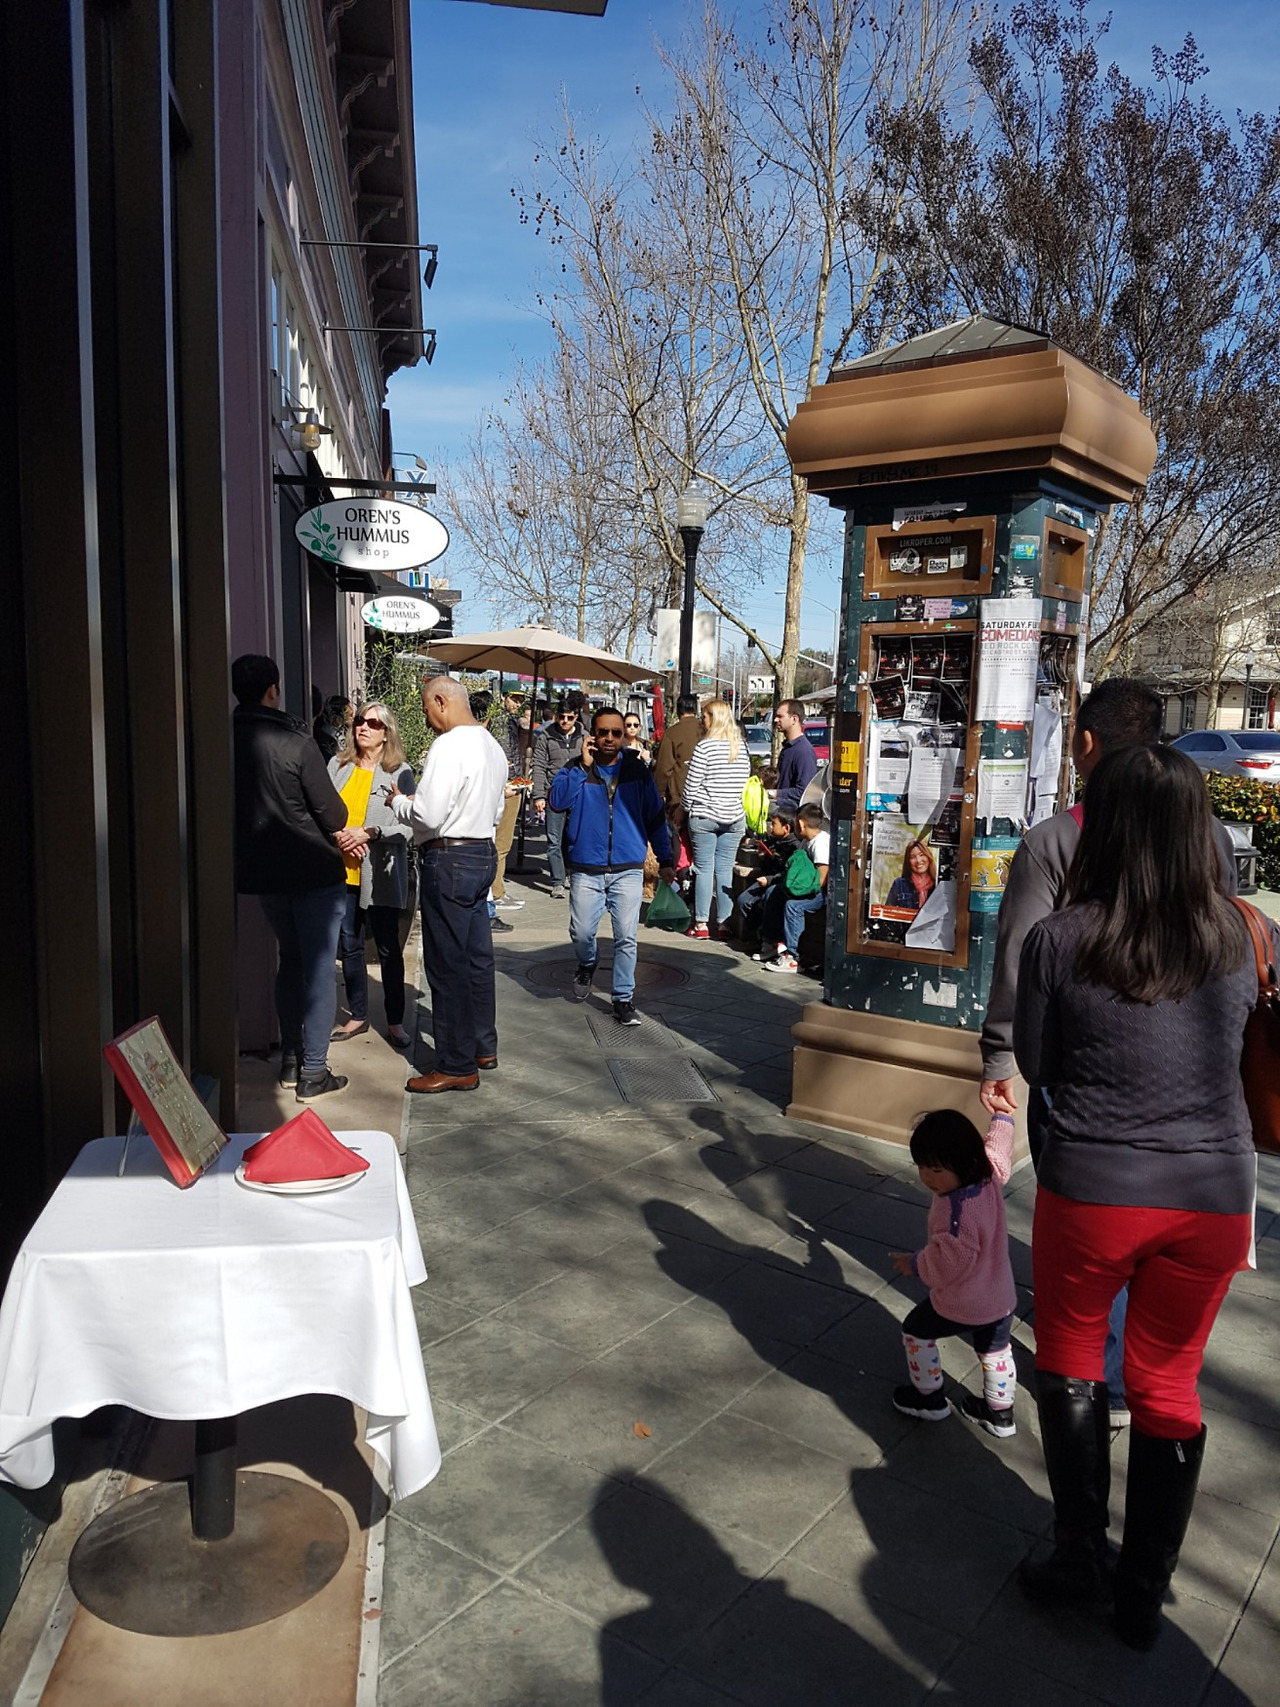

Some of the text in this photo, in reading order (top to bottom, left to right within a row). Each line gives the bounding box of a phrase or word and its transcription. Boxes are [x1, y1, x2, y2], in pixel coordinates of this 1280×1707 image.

[345, 508, 401, 524] OREN'S
[336, 526, 410, 544] HUMMUS
[357, 546, 390, 559] shop
[386, 600, 416, 609] OREN'S
[382, 610, 421, 620] HUMMUS
